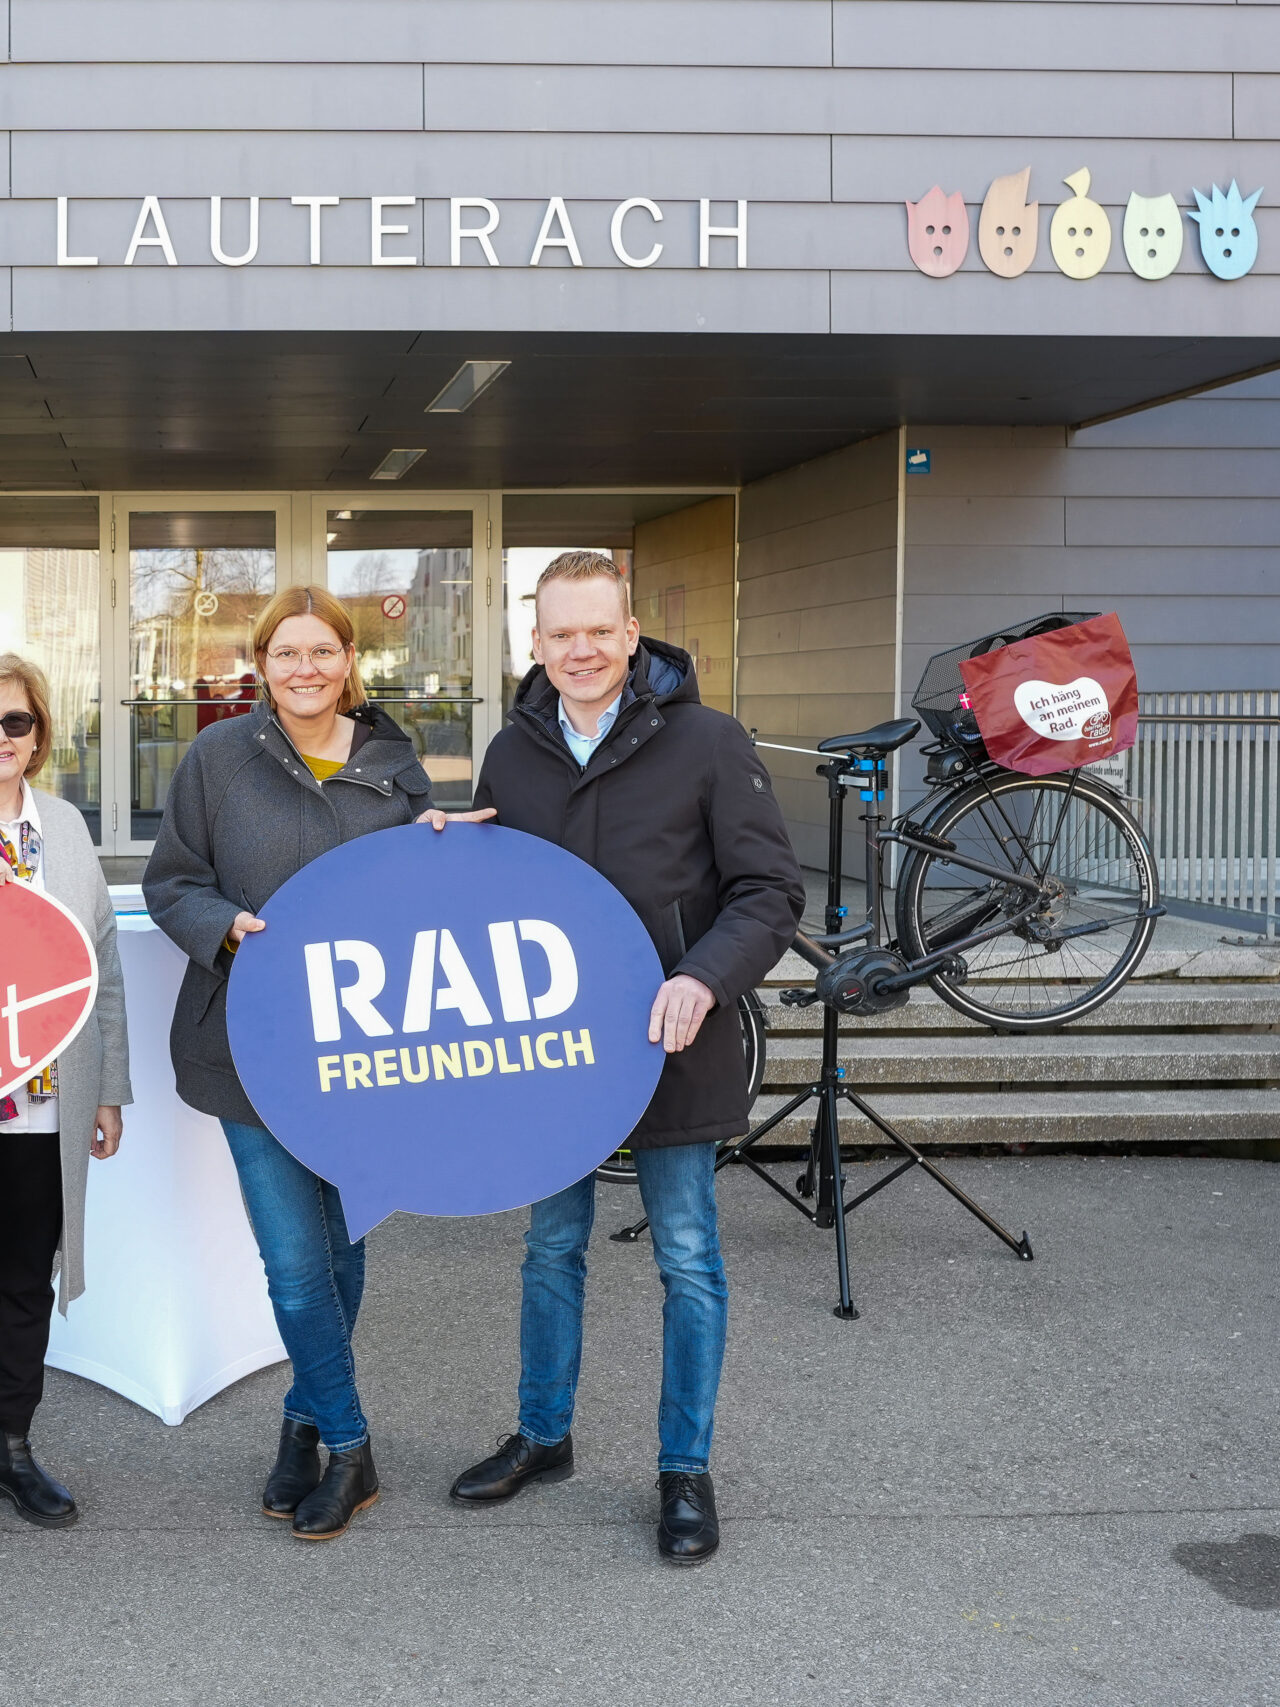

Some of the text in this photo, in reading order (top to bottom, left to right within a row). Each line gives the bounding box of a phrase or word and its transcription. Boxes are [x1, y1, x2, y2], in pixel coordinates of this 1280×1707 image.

[57, 196, 749, 269] LAUTERACH
[1030, 688, 1081, 711] Ich häng
[1039, 697, 1101, 722] an meinem
[1049, 717, 1078, 734] Rad.
[304, 918, 579, 1043] RAD
[317, 1028, 595, 1092] FREUNDLICH
